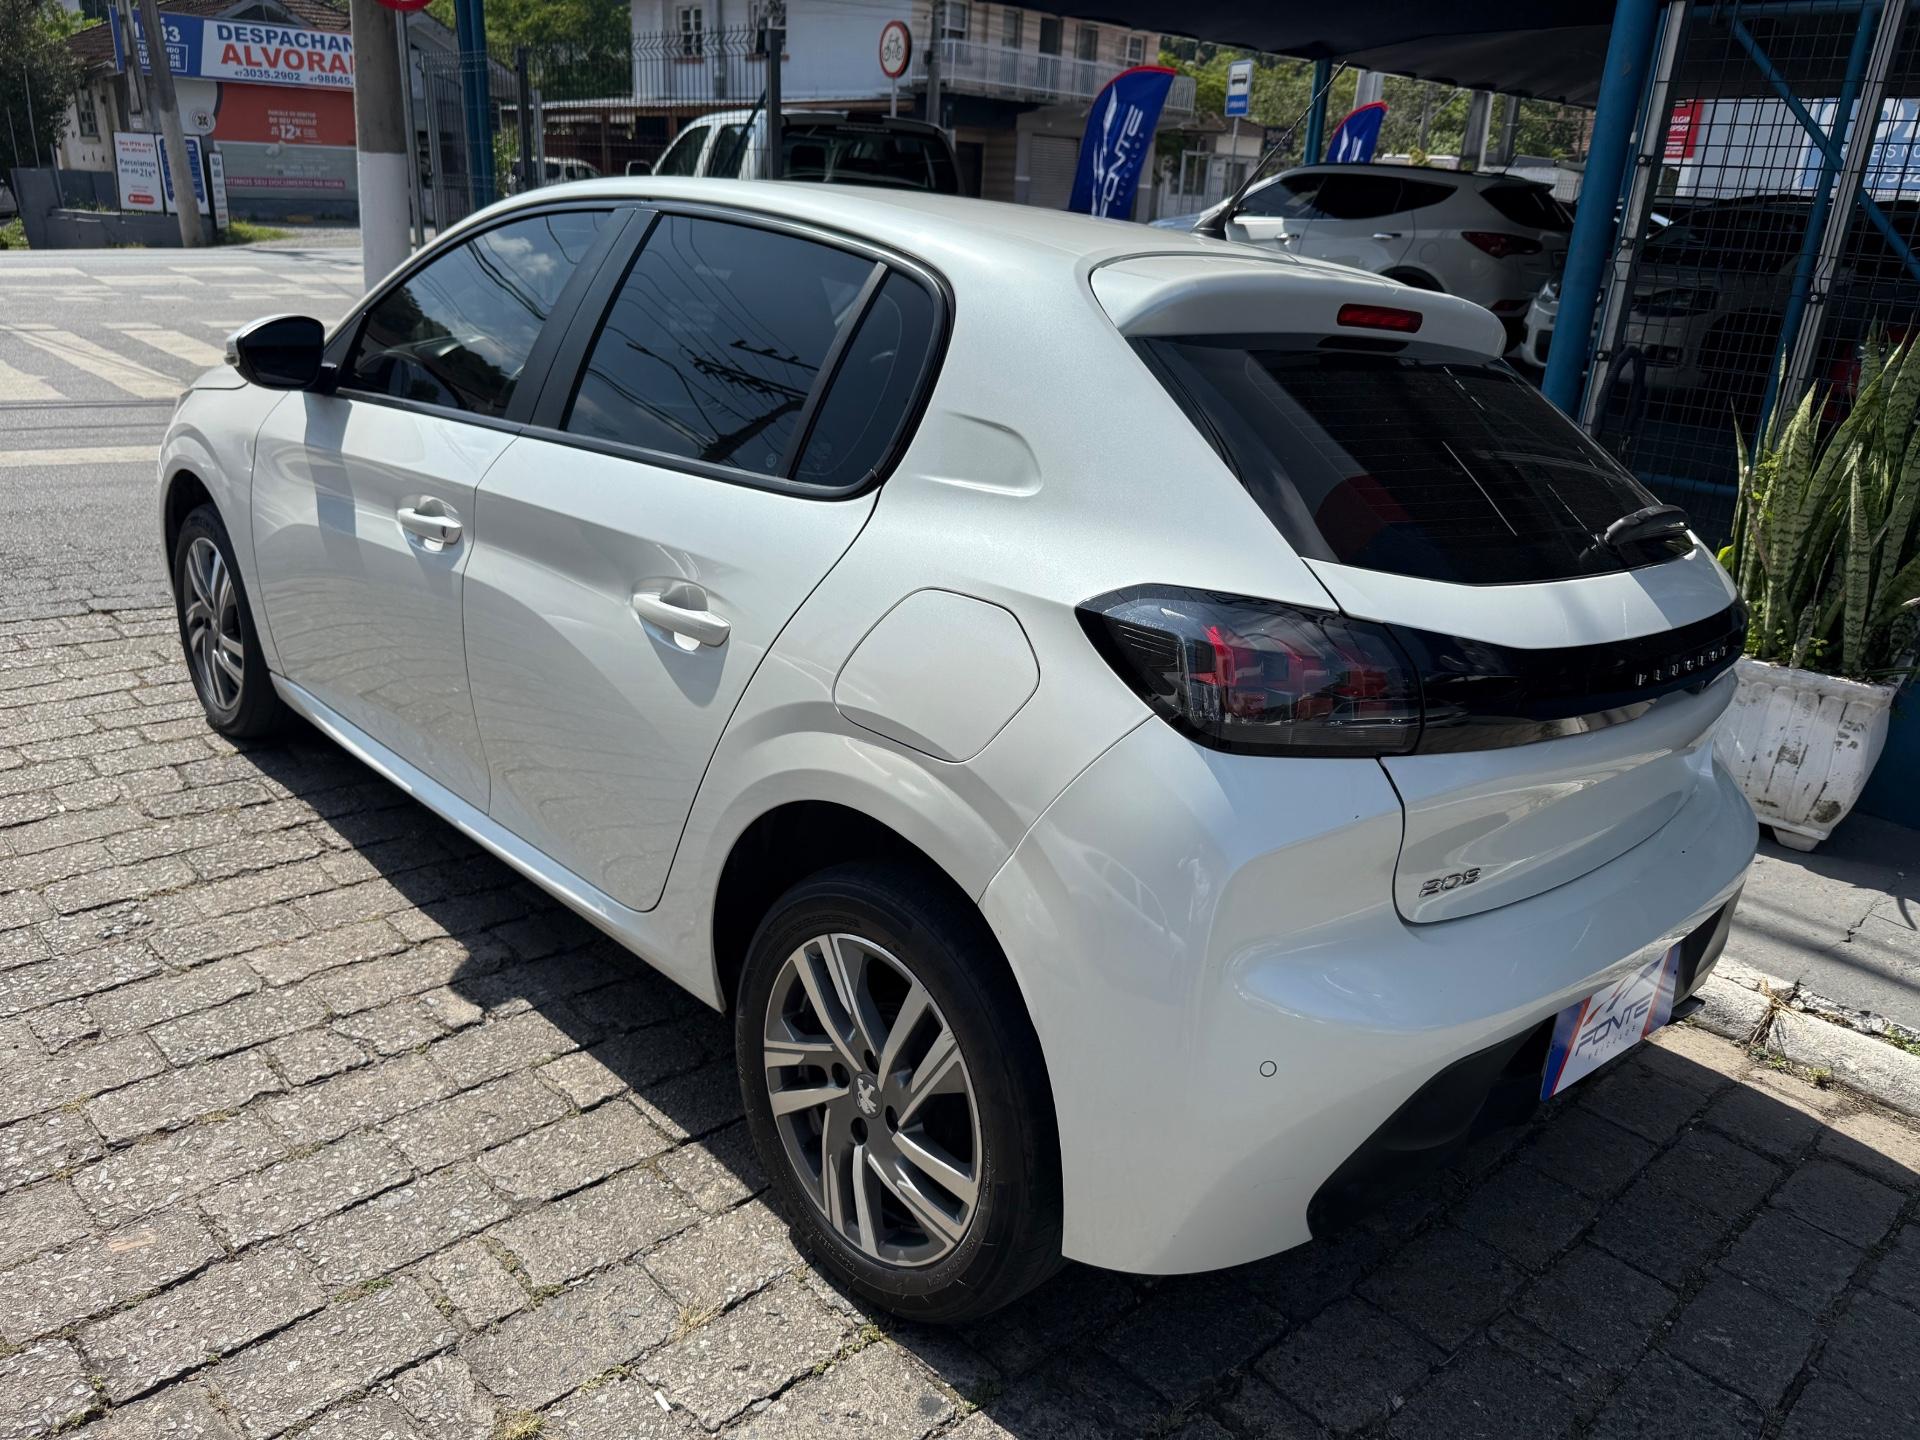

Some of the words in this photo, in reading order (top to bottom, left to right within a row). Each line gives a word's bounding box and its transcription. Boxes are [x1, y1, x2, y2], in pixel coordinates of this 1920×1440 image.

[220, 43, 353, 76] ALVORA
[1418, 867, 1481, 898] 208
[1575, 992, 1654, 1057] FONTE
